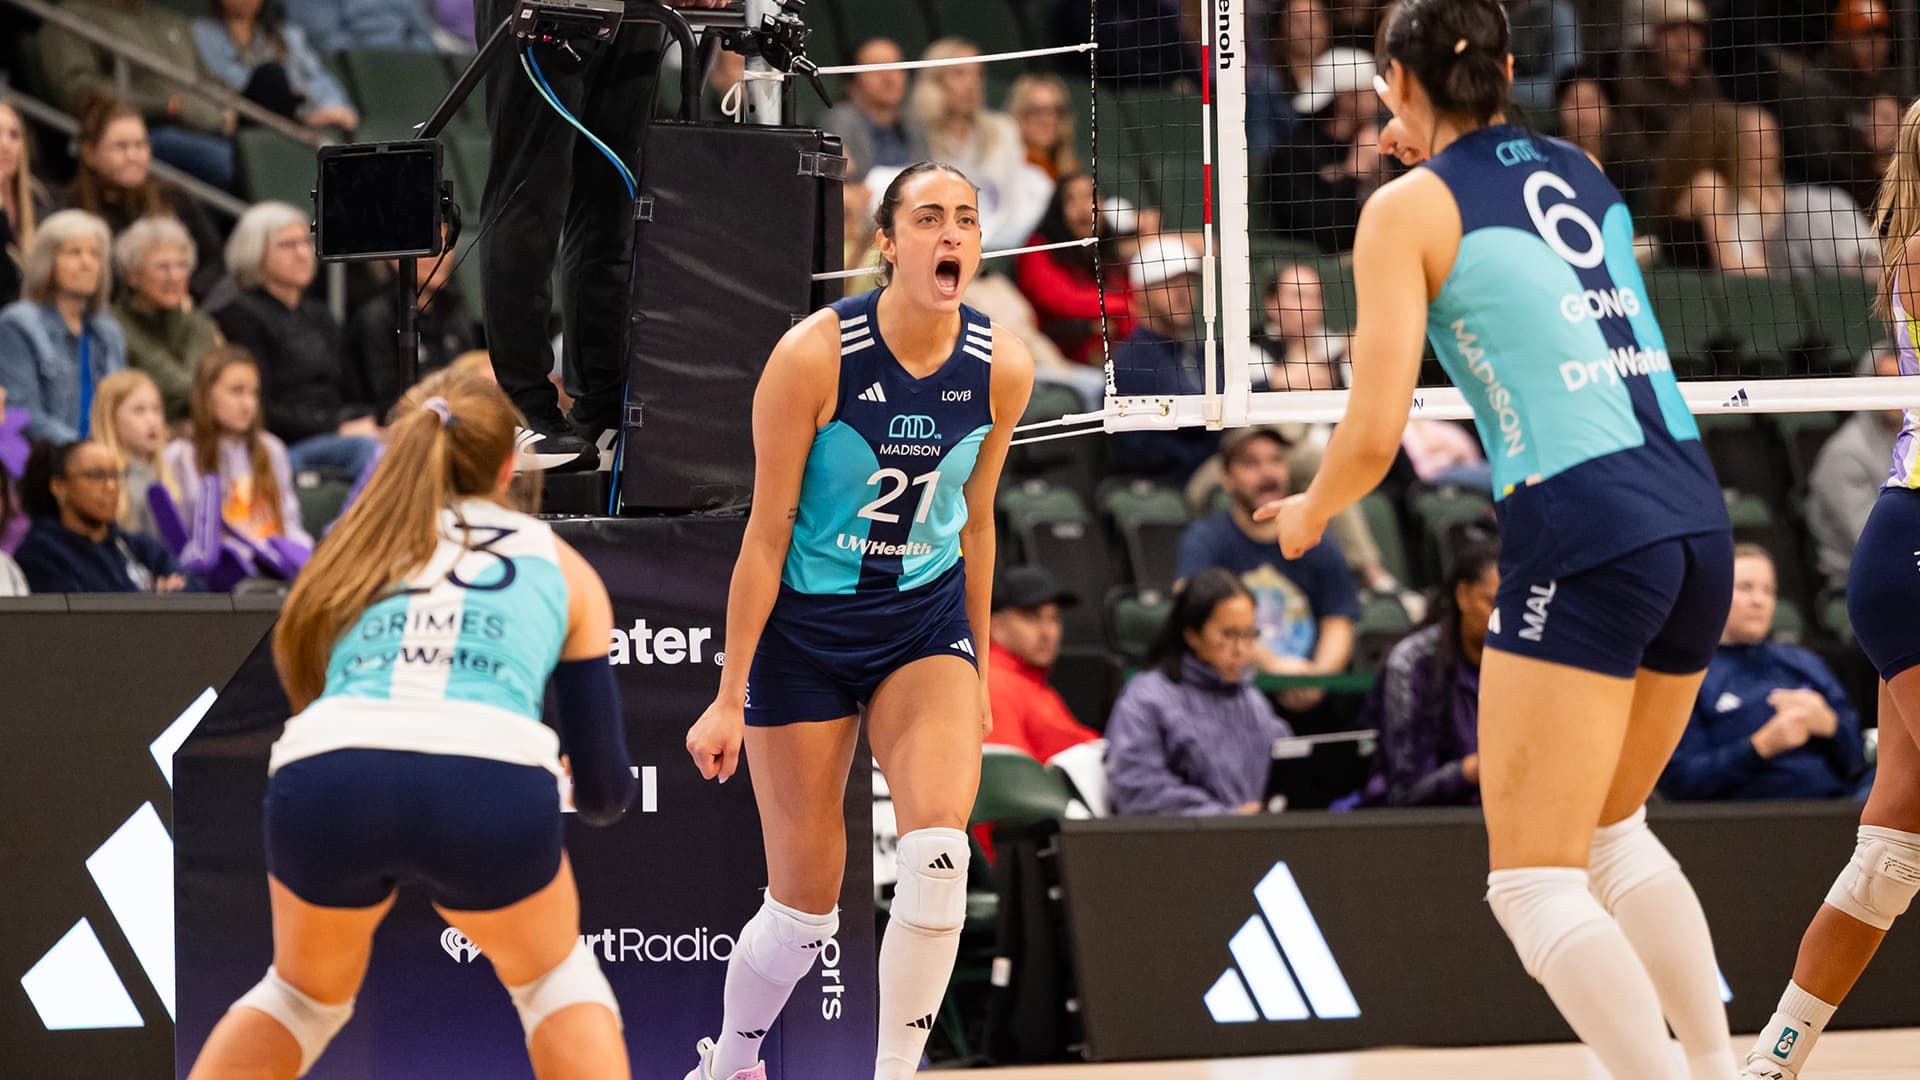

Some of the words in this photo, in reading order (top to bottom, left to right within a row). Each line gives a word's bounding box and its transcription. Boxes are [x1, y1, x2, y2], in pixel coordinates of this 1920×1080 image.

[1524, 171, 1604, 269] 6
[1560, 288, 1640, 322] GONG
[1451, 319, 1525, 458] MADISON
[880, 444, 941, 456] MADISON
[857, 468, 940, 523] 21
[361, 611, 504, 641] GRIMES
[582, 927, 736, 962] rtRadio
